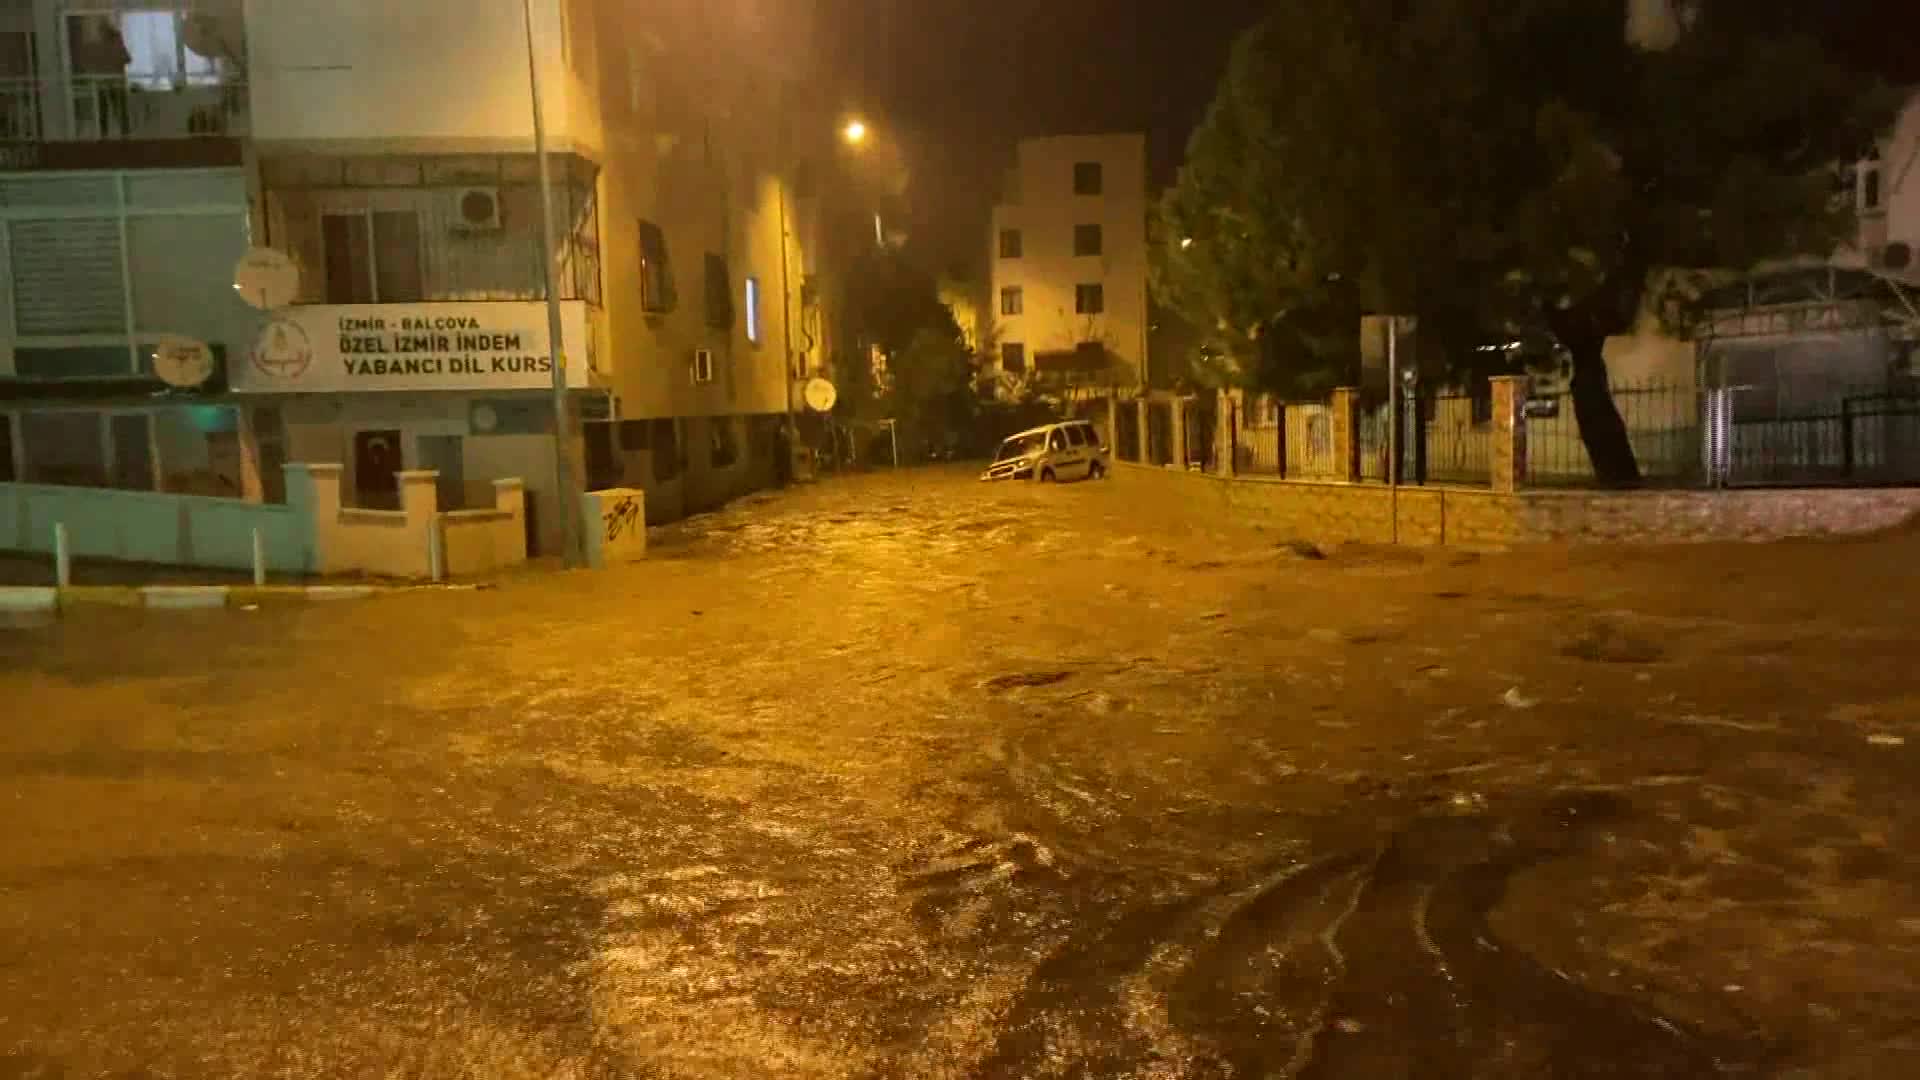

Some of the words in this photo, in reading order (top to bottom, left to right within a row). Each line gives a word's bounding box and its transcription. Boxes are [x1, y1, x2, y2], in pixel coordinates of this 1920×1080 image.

[339, 316, 385, 331] İZMİR
[402, 317, 480, 332] BALÇOVA
[340, 333, 386, 353] ÖZEL
[394, 333, 450, 352] İZMİR
[457, 332, 521, 351] İNDEM
[344, 358, 443, 375] YABANCI
[450, 355, 484, 374] DİL
[491, 355, 556, 373] KURS
